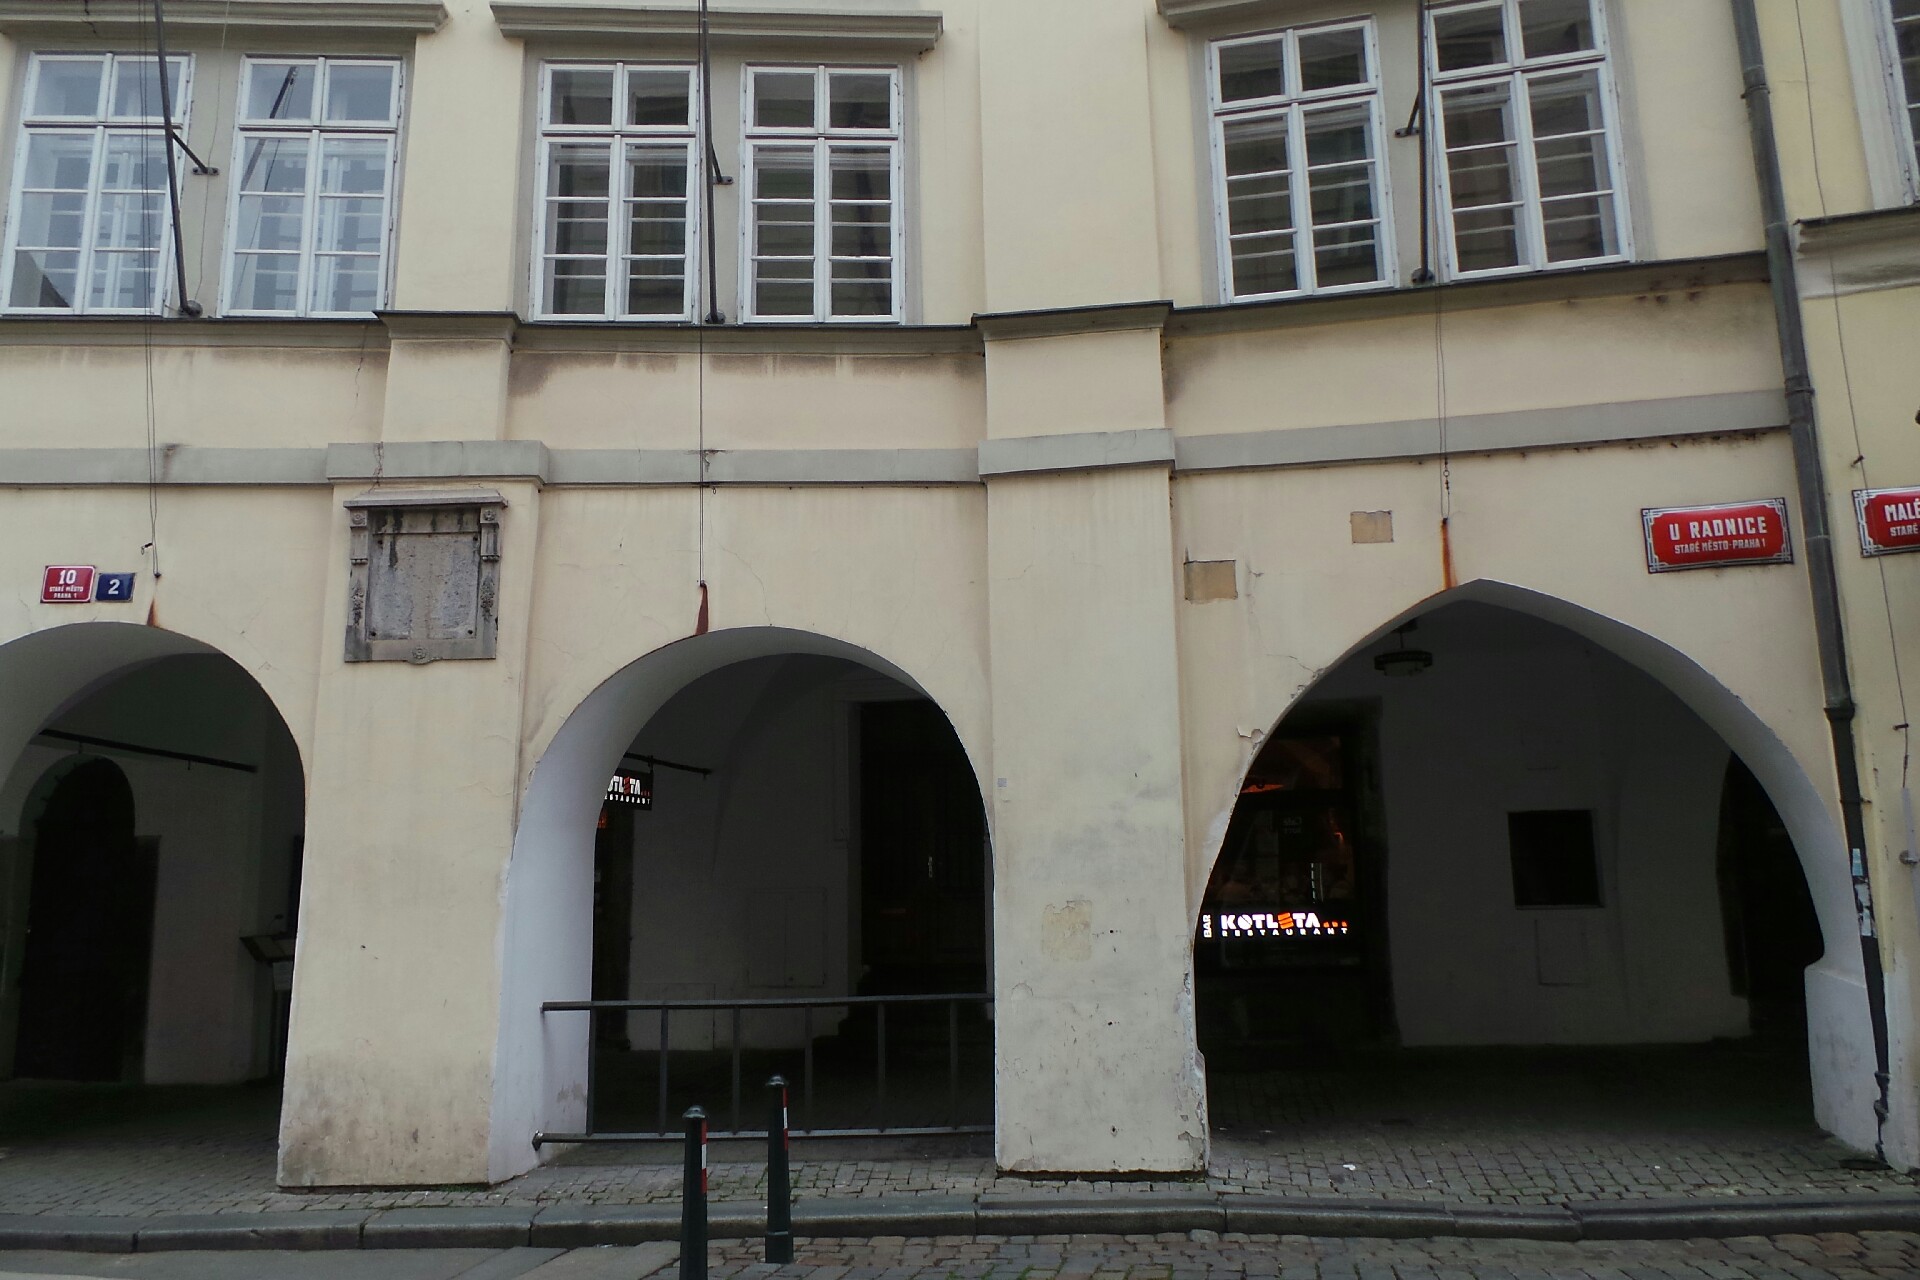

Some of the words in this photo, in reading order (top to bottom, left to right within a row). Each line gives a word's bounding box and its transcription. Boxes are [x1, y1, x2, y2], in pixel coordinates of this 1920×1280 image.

[1884, 497, 1920, 522] MALÉ
[1669, 523, 1680, 541] U
[1689, 516, 1768, 539] RADNICE
[1889, 523, 1919, 537] STARÉ
[1674, 540, 1700, 554] STARÉ
[1761, 538, 1766, 548] 1
[58, 569, 77, 585] 10
[107, 578, 121, 595] 2
[1202, 914, 1212, 938] BAR
[1221, 928, 1348, 937] RESTAURANT
